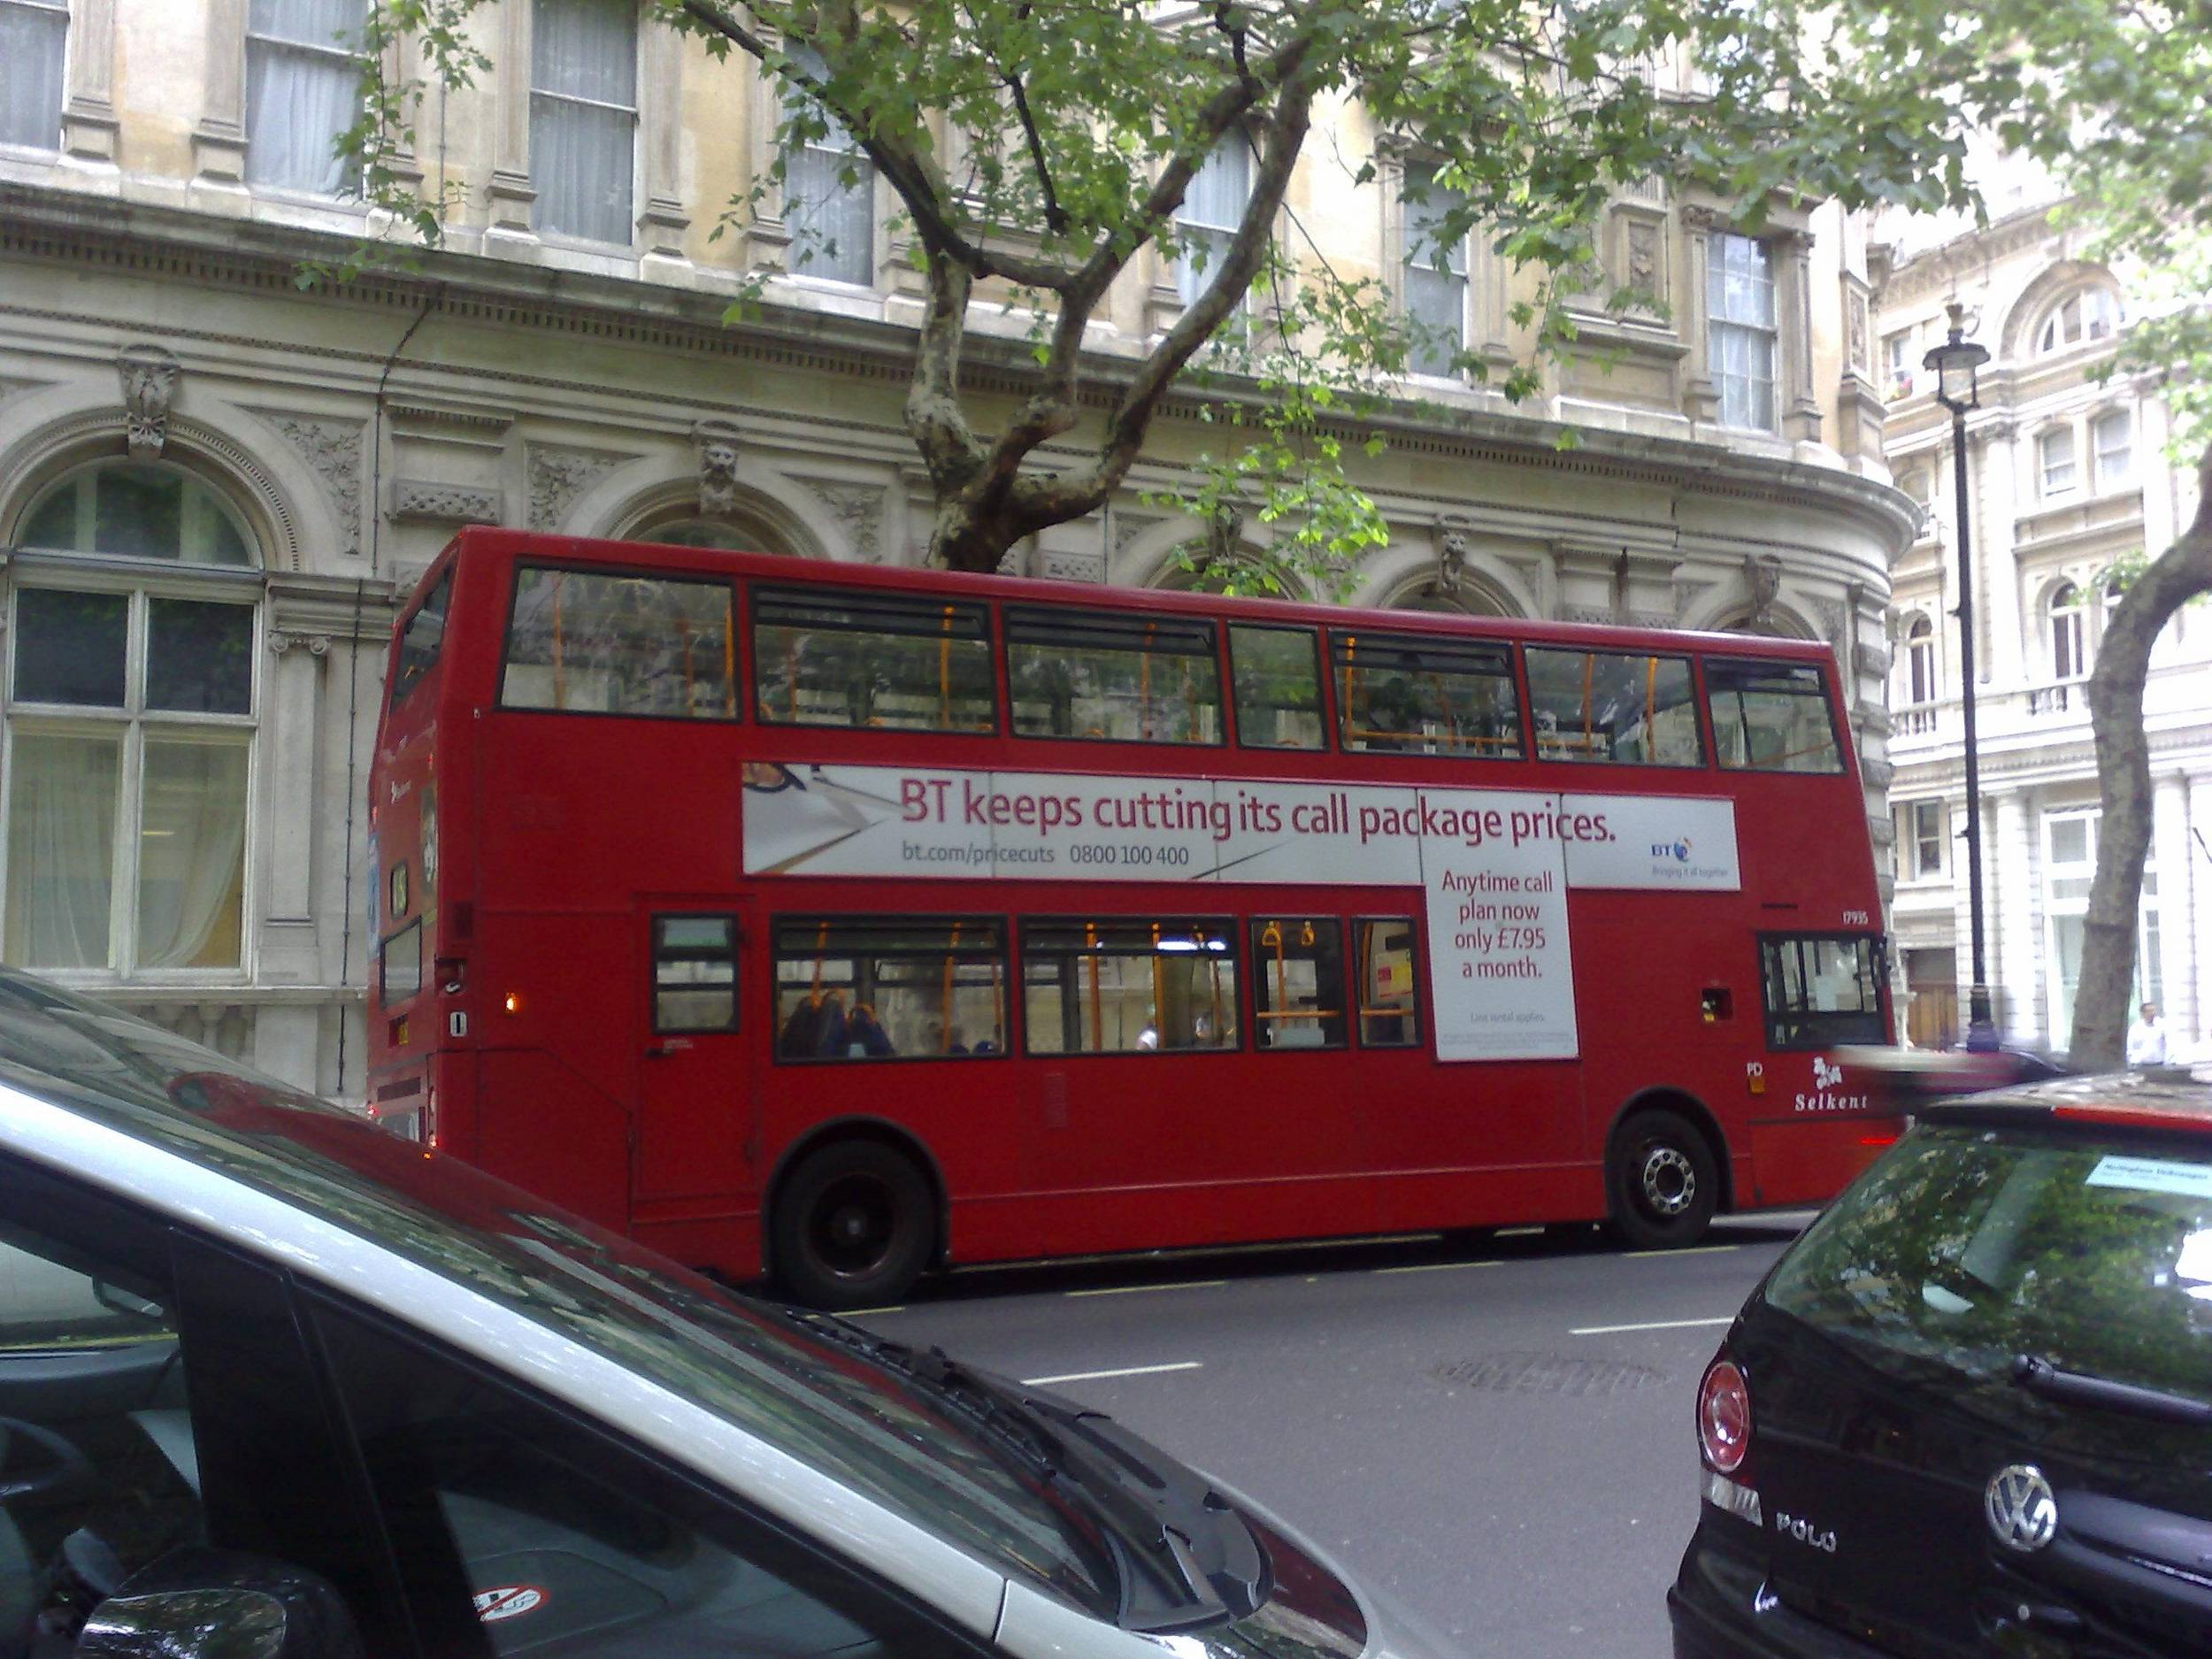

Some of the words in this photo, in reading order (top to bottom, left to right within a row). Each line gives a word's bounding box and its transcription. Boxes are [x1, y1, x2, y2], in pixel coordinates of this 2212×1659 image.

[901, 778, 951, 823] BT
[964, 779, 1083, 836] keeps
[1093, 787, 1231, 841] cutting
[1239, 790, 1281, 832] its
[1292, 793, 1348, 833] call
[1359, 795, 1502, 846] package
[1510, 801, 1616, 847] prices.
[902, 841, 1055, 865] bt.com/pricecuts
[1070, 844, 1116, 864] 0800
[1121, 846, 1152, 864] 100
[1156, 847, 1188, 865] 400
[1441, 870, 1520, 896] Anytime
[1524, 871, 1553, 892] call
[1460, 898, 1497, 925] plan
[1502, 905, 1540, 920] now
[1455, 927, 1493, 955] only
[1497, 927, 1547, 949] £7.95
[1463, 962, 1472, 978] a
[1478, 956, 1542, 979] month.
[1795, 1094, 1868, 1111] Selkent
[1776, 1511, 1837, 1553] POLO
